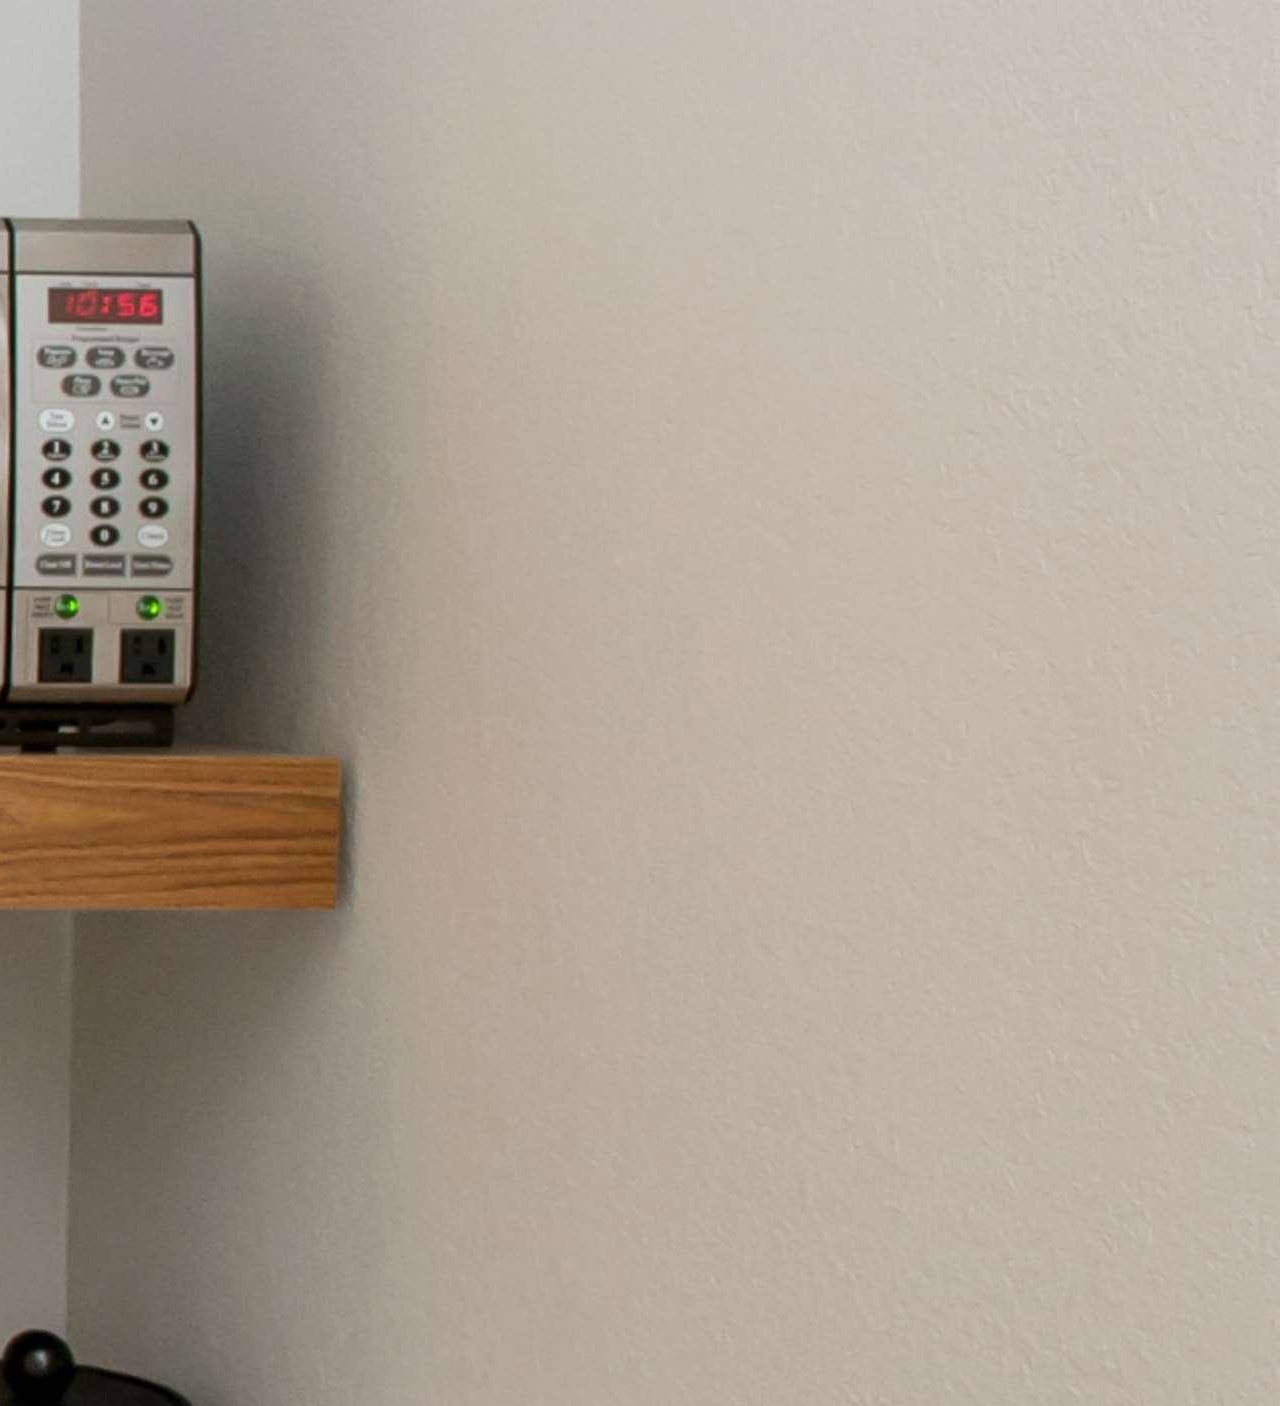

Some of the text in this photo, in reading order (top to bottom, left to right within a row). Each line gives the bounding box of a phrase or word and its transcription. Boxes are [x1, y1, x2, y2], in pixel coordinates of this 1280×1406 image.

[64, 291, 159, 318] 10:56
[50, 471, 60, 484] 4
[100, 472, 110, 486] 5
[147, 473, 159, 486] 6
[50, 500, 61, 513] 7
[100, 501, 110, 514] 8
[147, 501, 159, 514] 9
[99, 528, 110, 542] 0
